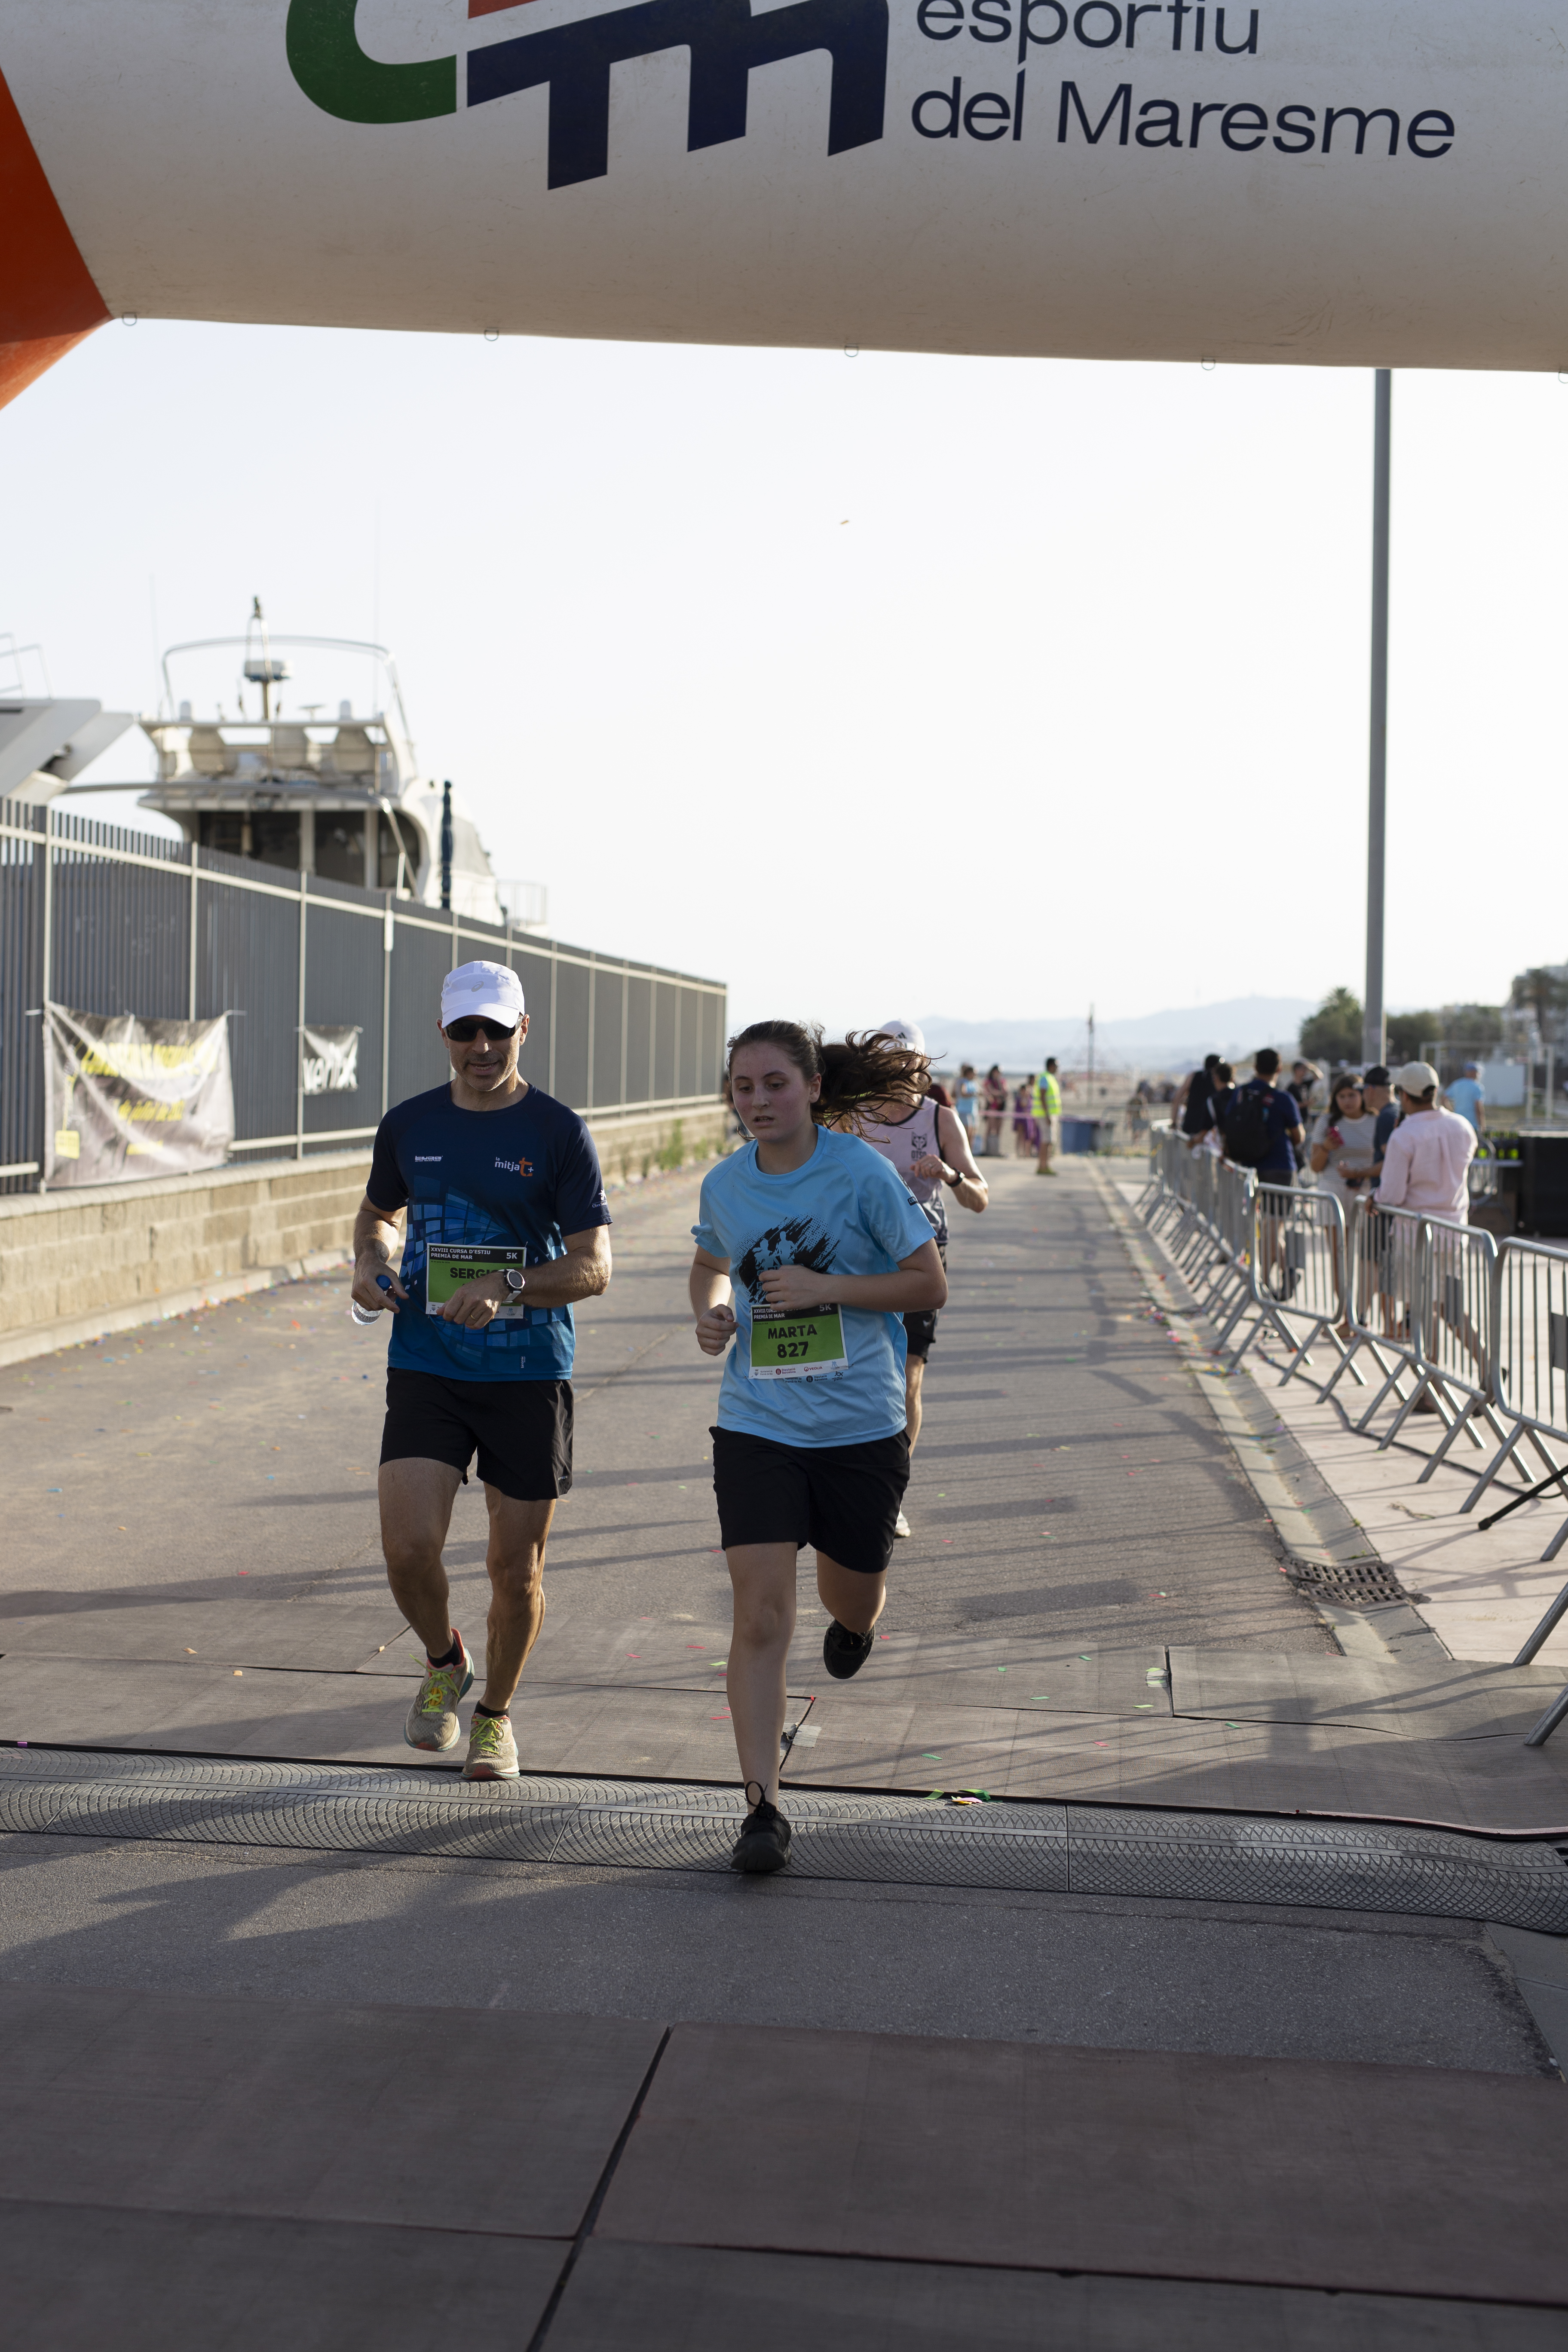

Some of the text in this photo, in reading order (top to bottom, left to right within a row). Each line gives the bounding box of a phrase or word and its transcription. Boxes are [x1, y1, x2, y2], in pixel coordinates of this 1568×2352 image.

[916, 0, 1259, 65] esportiu
[911, 68, 1455, 158] del Maresme
[450, 1267, 499, 1280] SERGI
[768, 1324, 818, 1339] MARTA
[777, 1341, 809, 1358] 827
